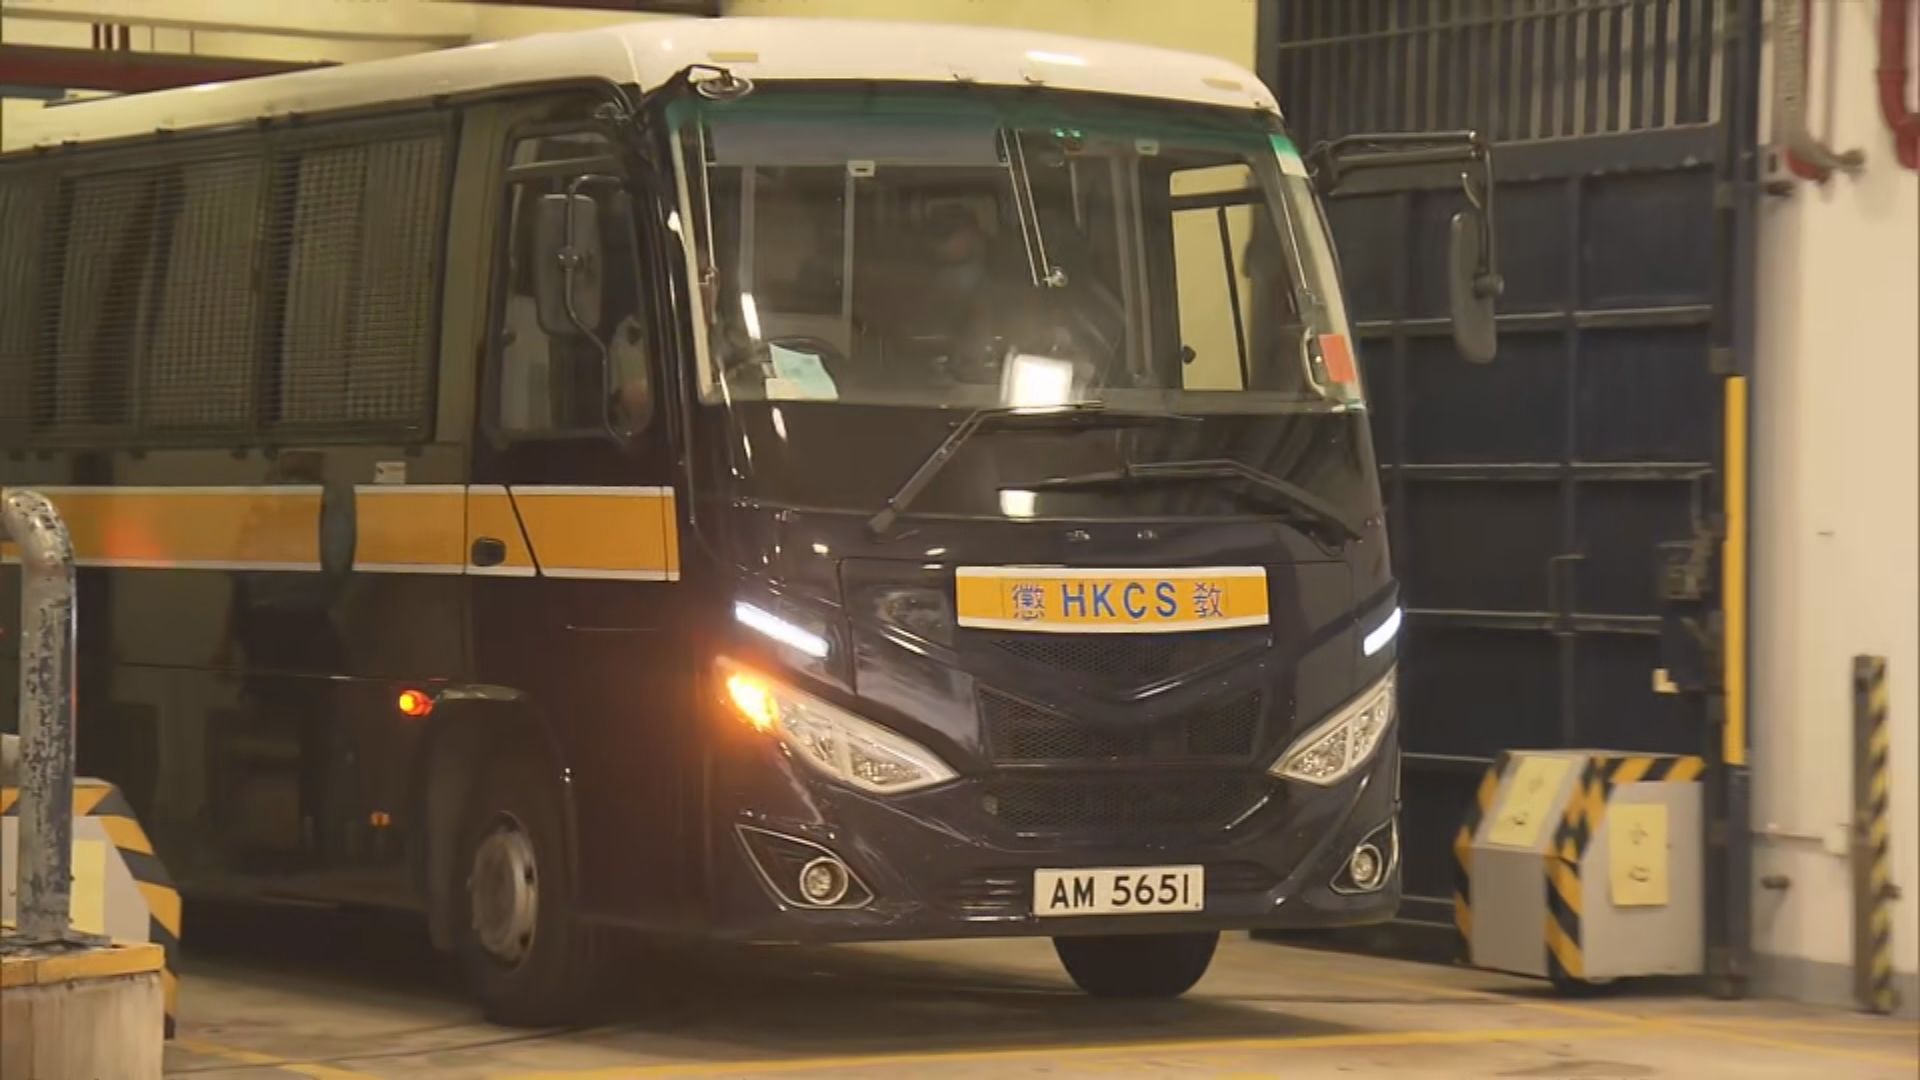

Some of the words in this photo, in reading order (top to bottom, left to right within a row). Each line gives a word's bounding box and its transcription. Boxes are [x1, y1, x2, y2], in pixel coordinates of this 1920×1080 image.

[1061, 582, 1178, 619] HKCS
[1050, 876, 1095, 909] AM
[1110, 874, 1189, 907] 5651
